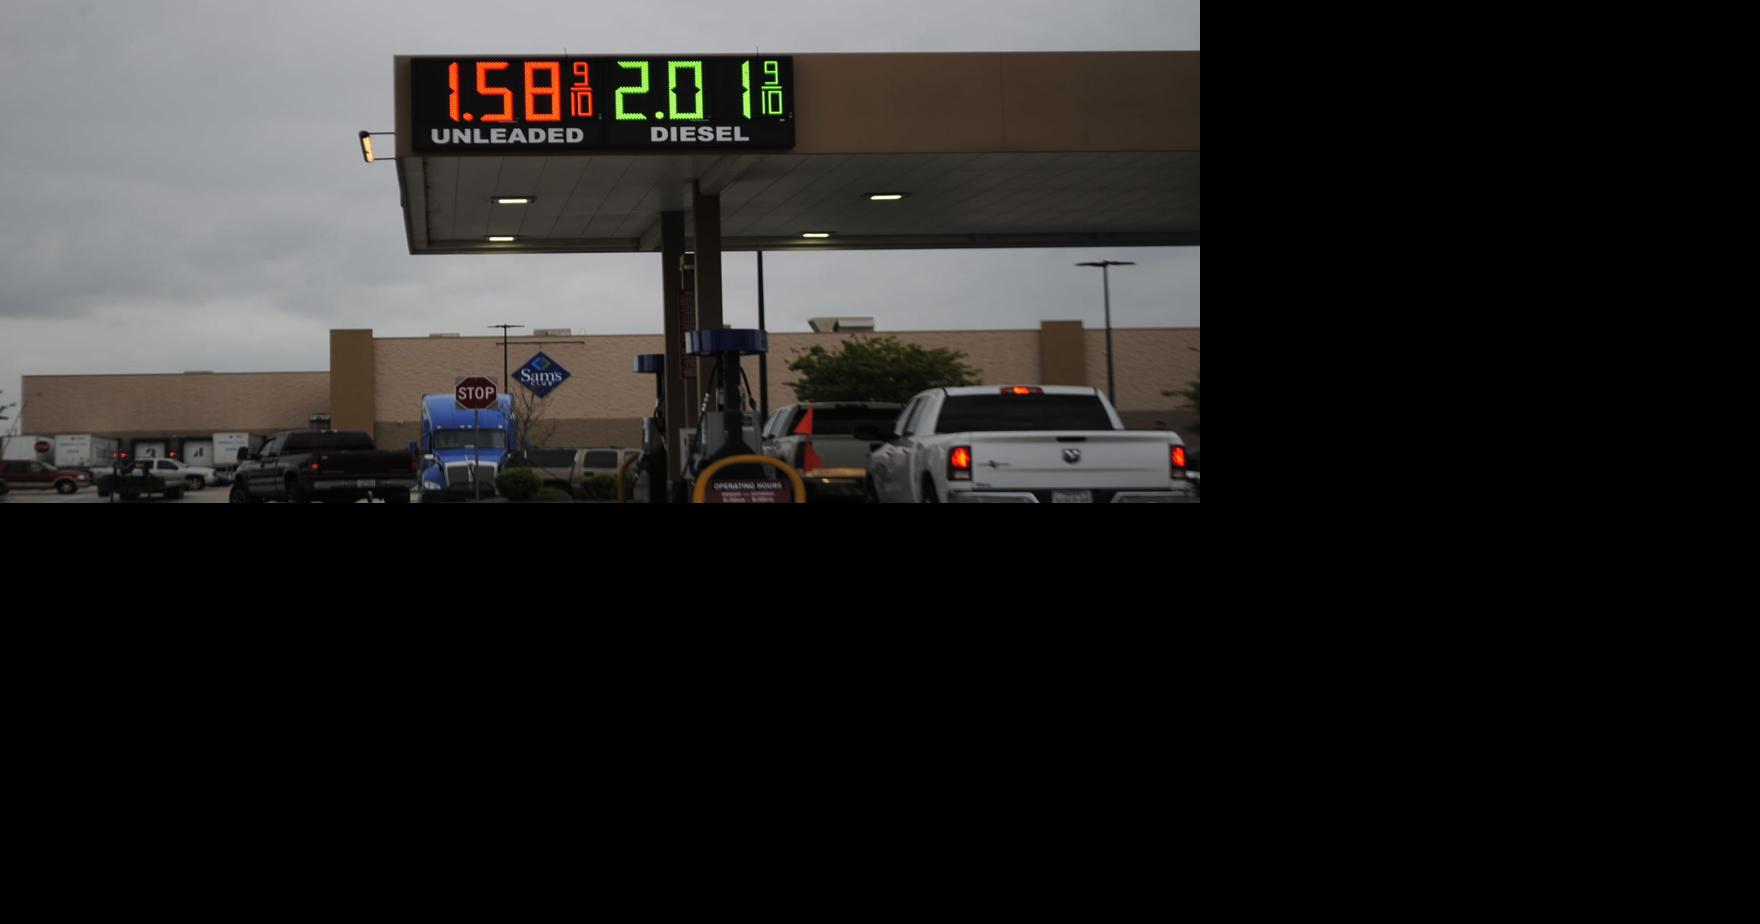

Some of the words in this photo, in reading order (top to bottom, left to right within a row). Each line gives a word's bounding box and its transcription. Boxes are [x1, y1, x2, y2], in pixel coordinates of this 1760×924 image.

[448, 61, 562, 122] 1.58
[614, 60, 752, 121] 2.01
[431, 127, 584, 144] UNLEADED
[650, 126, 750, 142] DIESEL
[458, 386, 495, 400] STOP
[713, 481, 755, 490] OPERATING
[756, 481, 783, 490] HOURS
